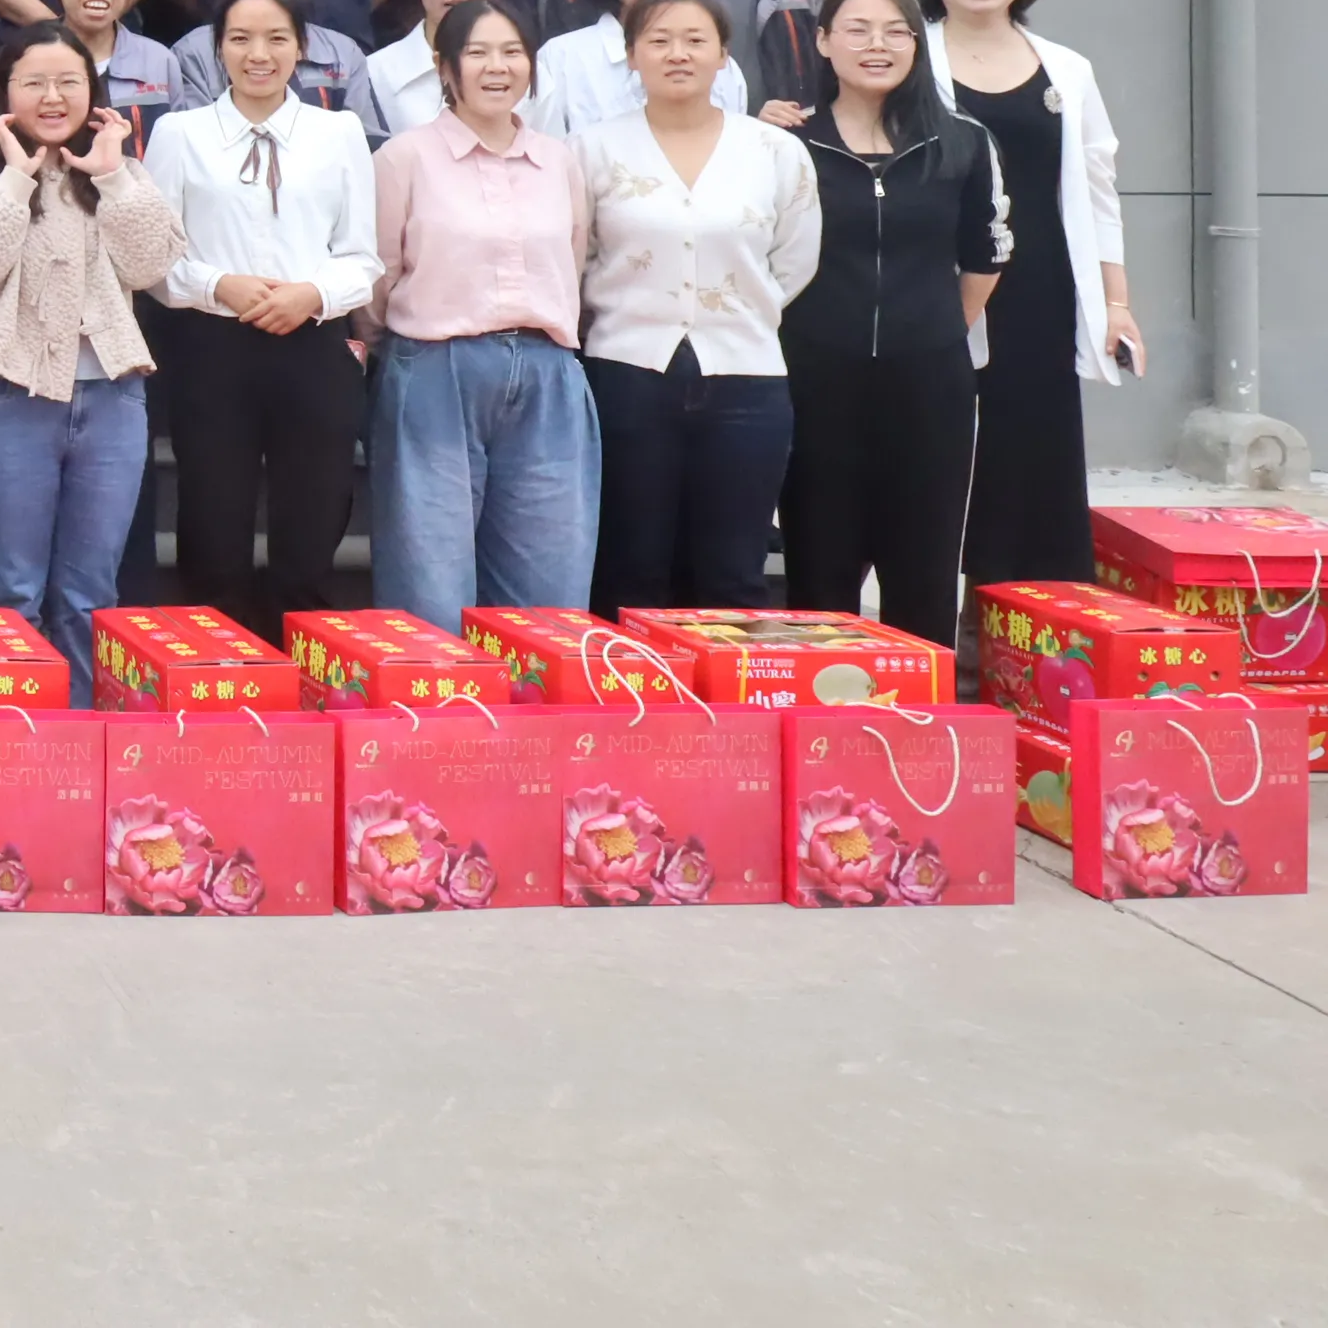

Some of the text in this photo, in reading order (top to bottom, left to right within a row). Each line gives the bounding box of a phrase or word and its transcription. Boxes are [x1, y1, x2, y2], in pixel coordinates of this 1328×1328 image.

[983, 603, 1061, 658] 冰糖心
[736, 658, 772, 668] FRUIT
[1140, 647, 1207, 665] 冰糖心
[736, 668, 795, 679] NATURAL
[191, 680, 260, 700] 冰糖心
[411, 679, 481, 699] 冰糖心
[156, 745, 323, 764] MID-AUTUMN
[391, 738, 552, 760] MID-AUTUMN
[607, 734, 770, 755] MID-AUTUMN
[437, 762, 551, 783] FESTIVAL
[654, 759, 770, 779] FESTIVAL
[204, 771, 323, 789] FESTIVAL
